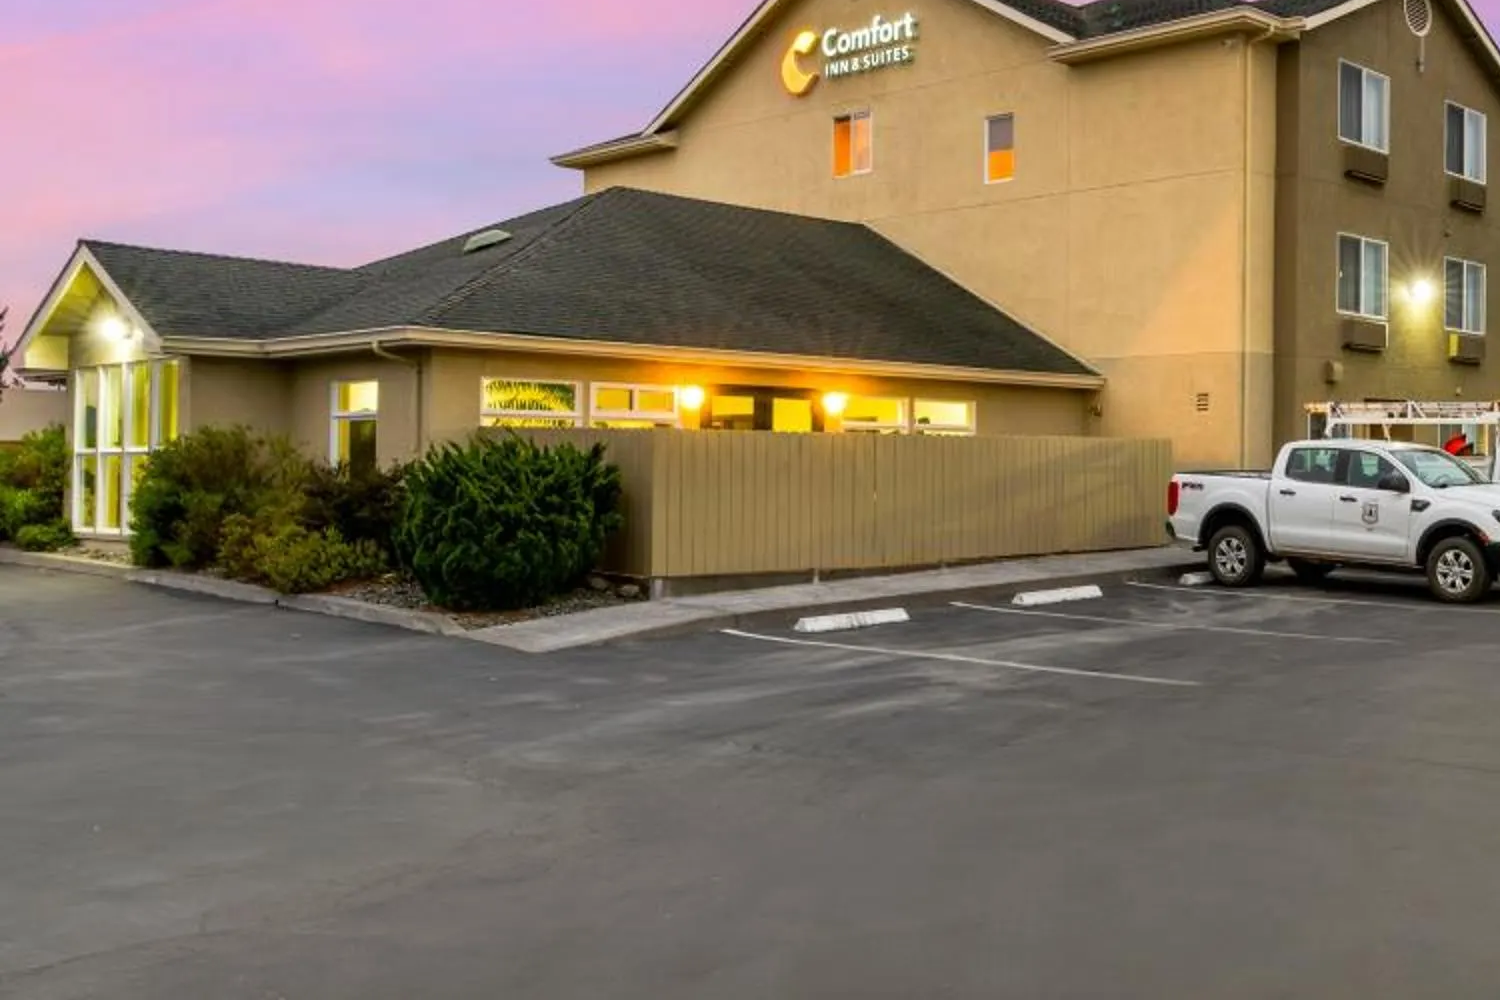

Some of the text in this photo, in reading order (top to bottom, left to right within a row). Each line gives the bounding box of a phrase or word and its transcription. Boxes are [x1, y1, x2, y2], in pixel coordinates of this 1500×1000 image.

[821, 12, 914, 57] Comfort
[825, 45, 909, 78] INN & SUITES
